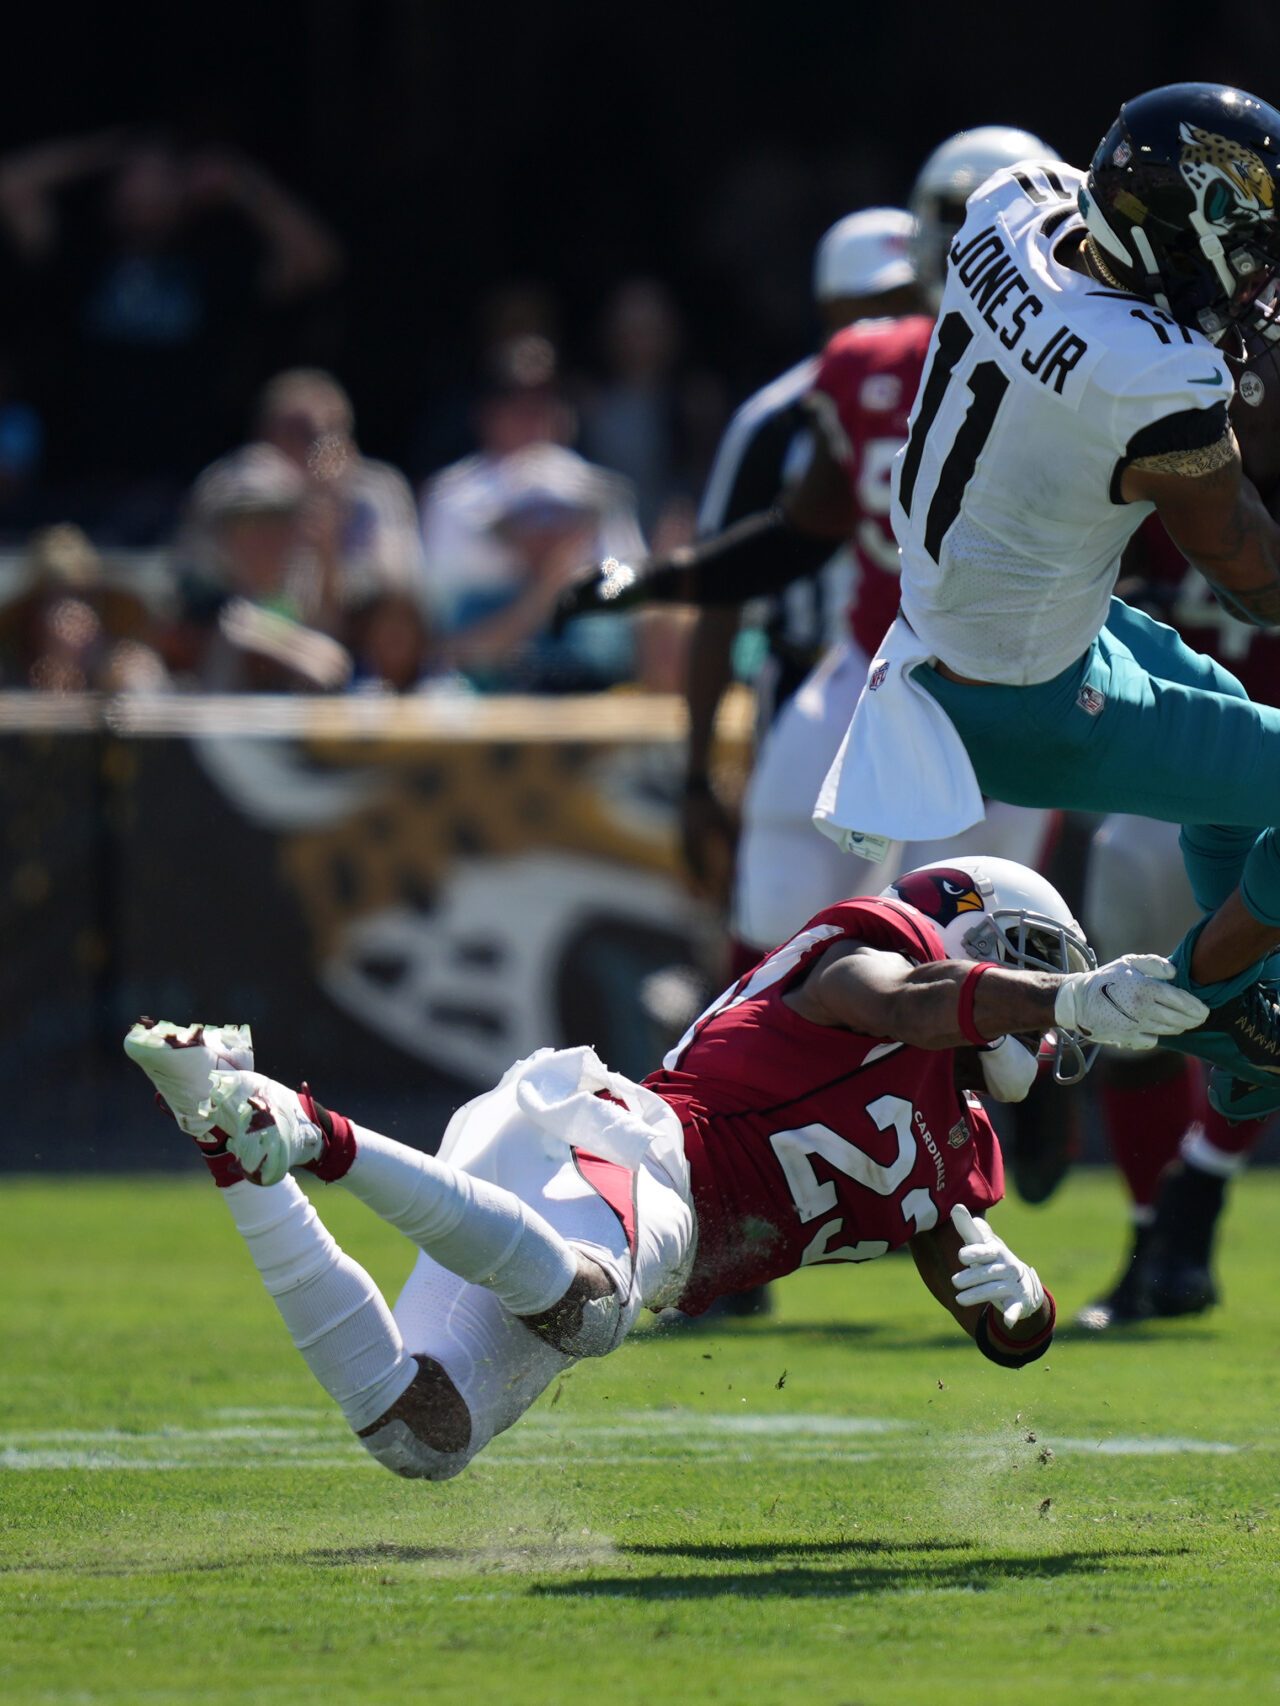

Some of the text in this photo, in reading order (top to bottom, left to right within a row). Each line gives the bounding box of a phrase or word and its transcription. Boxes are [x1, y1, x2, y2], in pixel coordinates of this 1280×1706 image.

[950, 225, 1088, 395] JONES JR
[898, 311, 1011, 567] 11
[914, 1110, 946, 1192] CARDINALS
